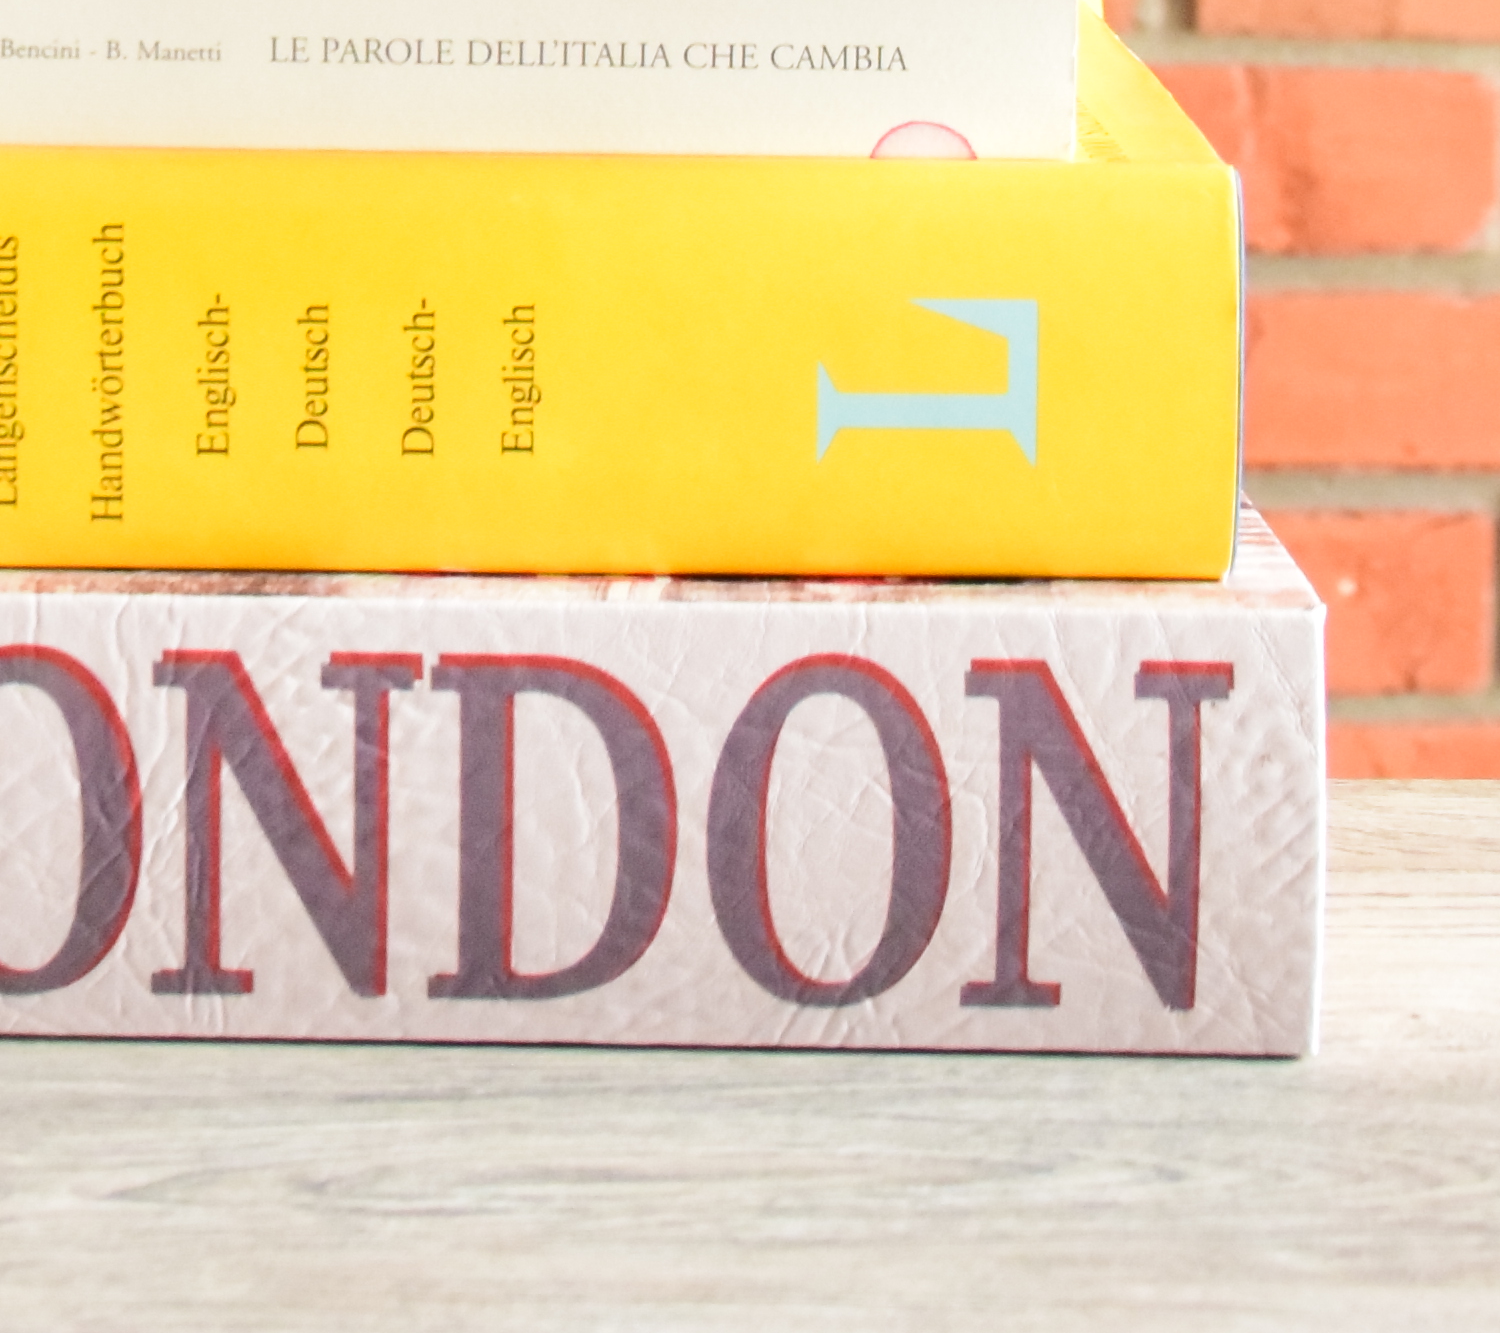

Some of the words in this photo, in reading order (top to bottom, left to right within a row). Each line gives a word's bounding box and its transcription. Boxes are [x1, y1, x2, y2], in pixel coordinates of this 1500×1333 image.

[0, 38, 82, 61] Bencini
[106, 39, 130, 61] B.
[137, 39, 223, 64] Manetti
[270, 36, 311, 65] LE
[320, 37, 455, 68] PAROLE
[466, 38, 671, 71] DELL'ITALIA
[683, 41, 760, 71] CHE
[770, 42, 910, 73] CAMBIA
[90, 220, 124, 524] Handwörterbuch
[195, 290, 237, 458] Englisch-
[295, 302, 330, 451] Deutsch
[401, 295, 437, 458] Deutsch-
[500, 302, 542, 456] Englisch
[816, 297, 1039, 469] L
